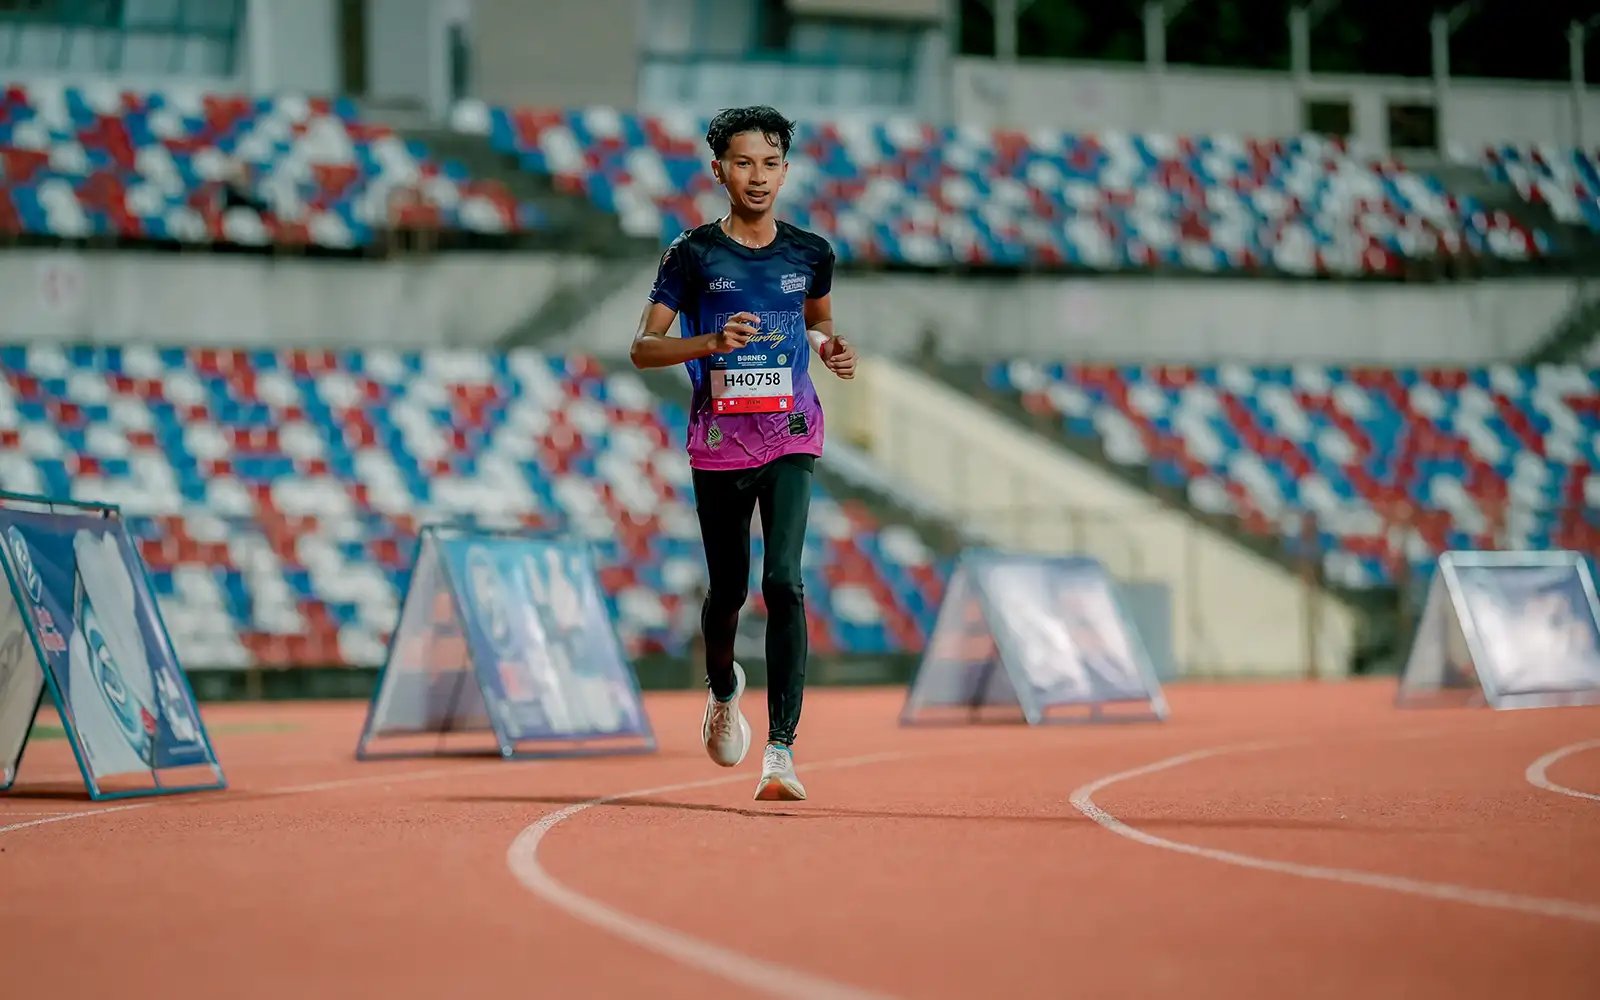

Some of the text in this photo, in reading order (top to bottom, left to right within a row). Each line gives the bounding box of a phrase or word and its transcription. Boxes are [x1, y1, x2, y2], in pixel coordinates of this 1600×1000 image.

[709, 280, 736, 290] BSRC
[737, 354, 767, 362] BORNEO
[724, 372, 780, 387] H40758
